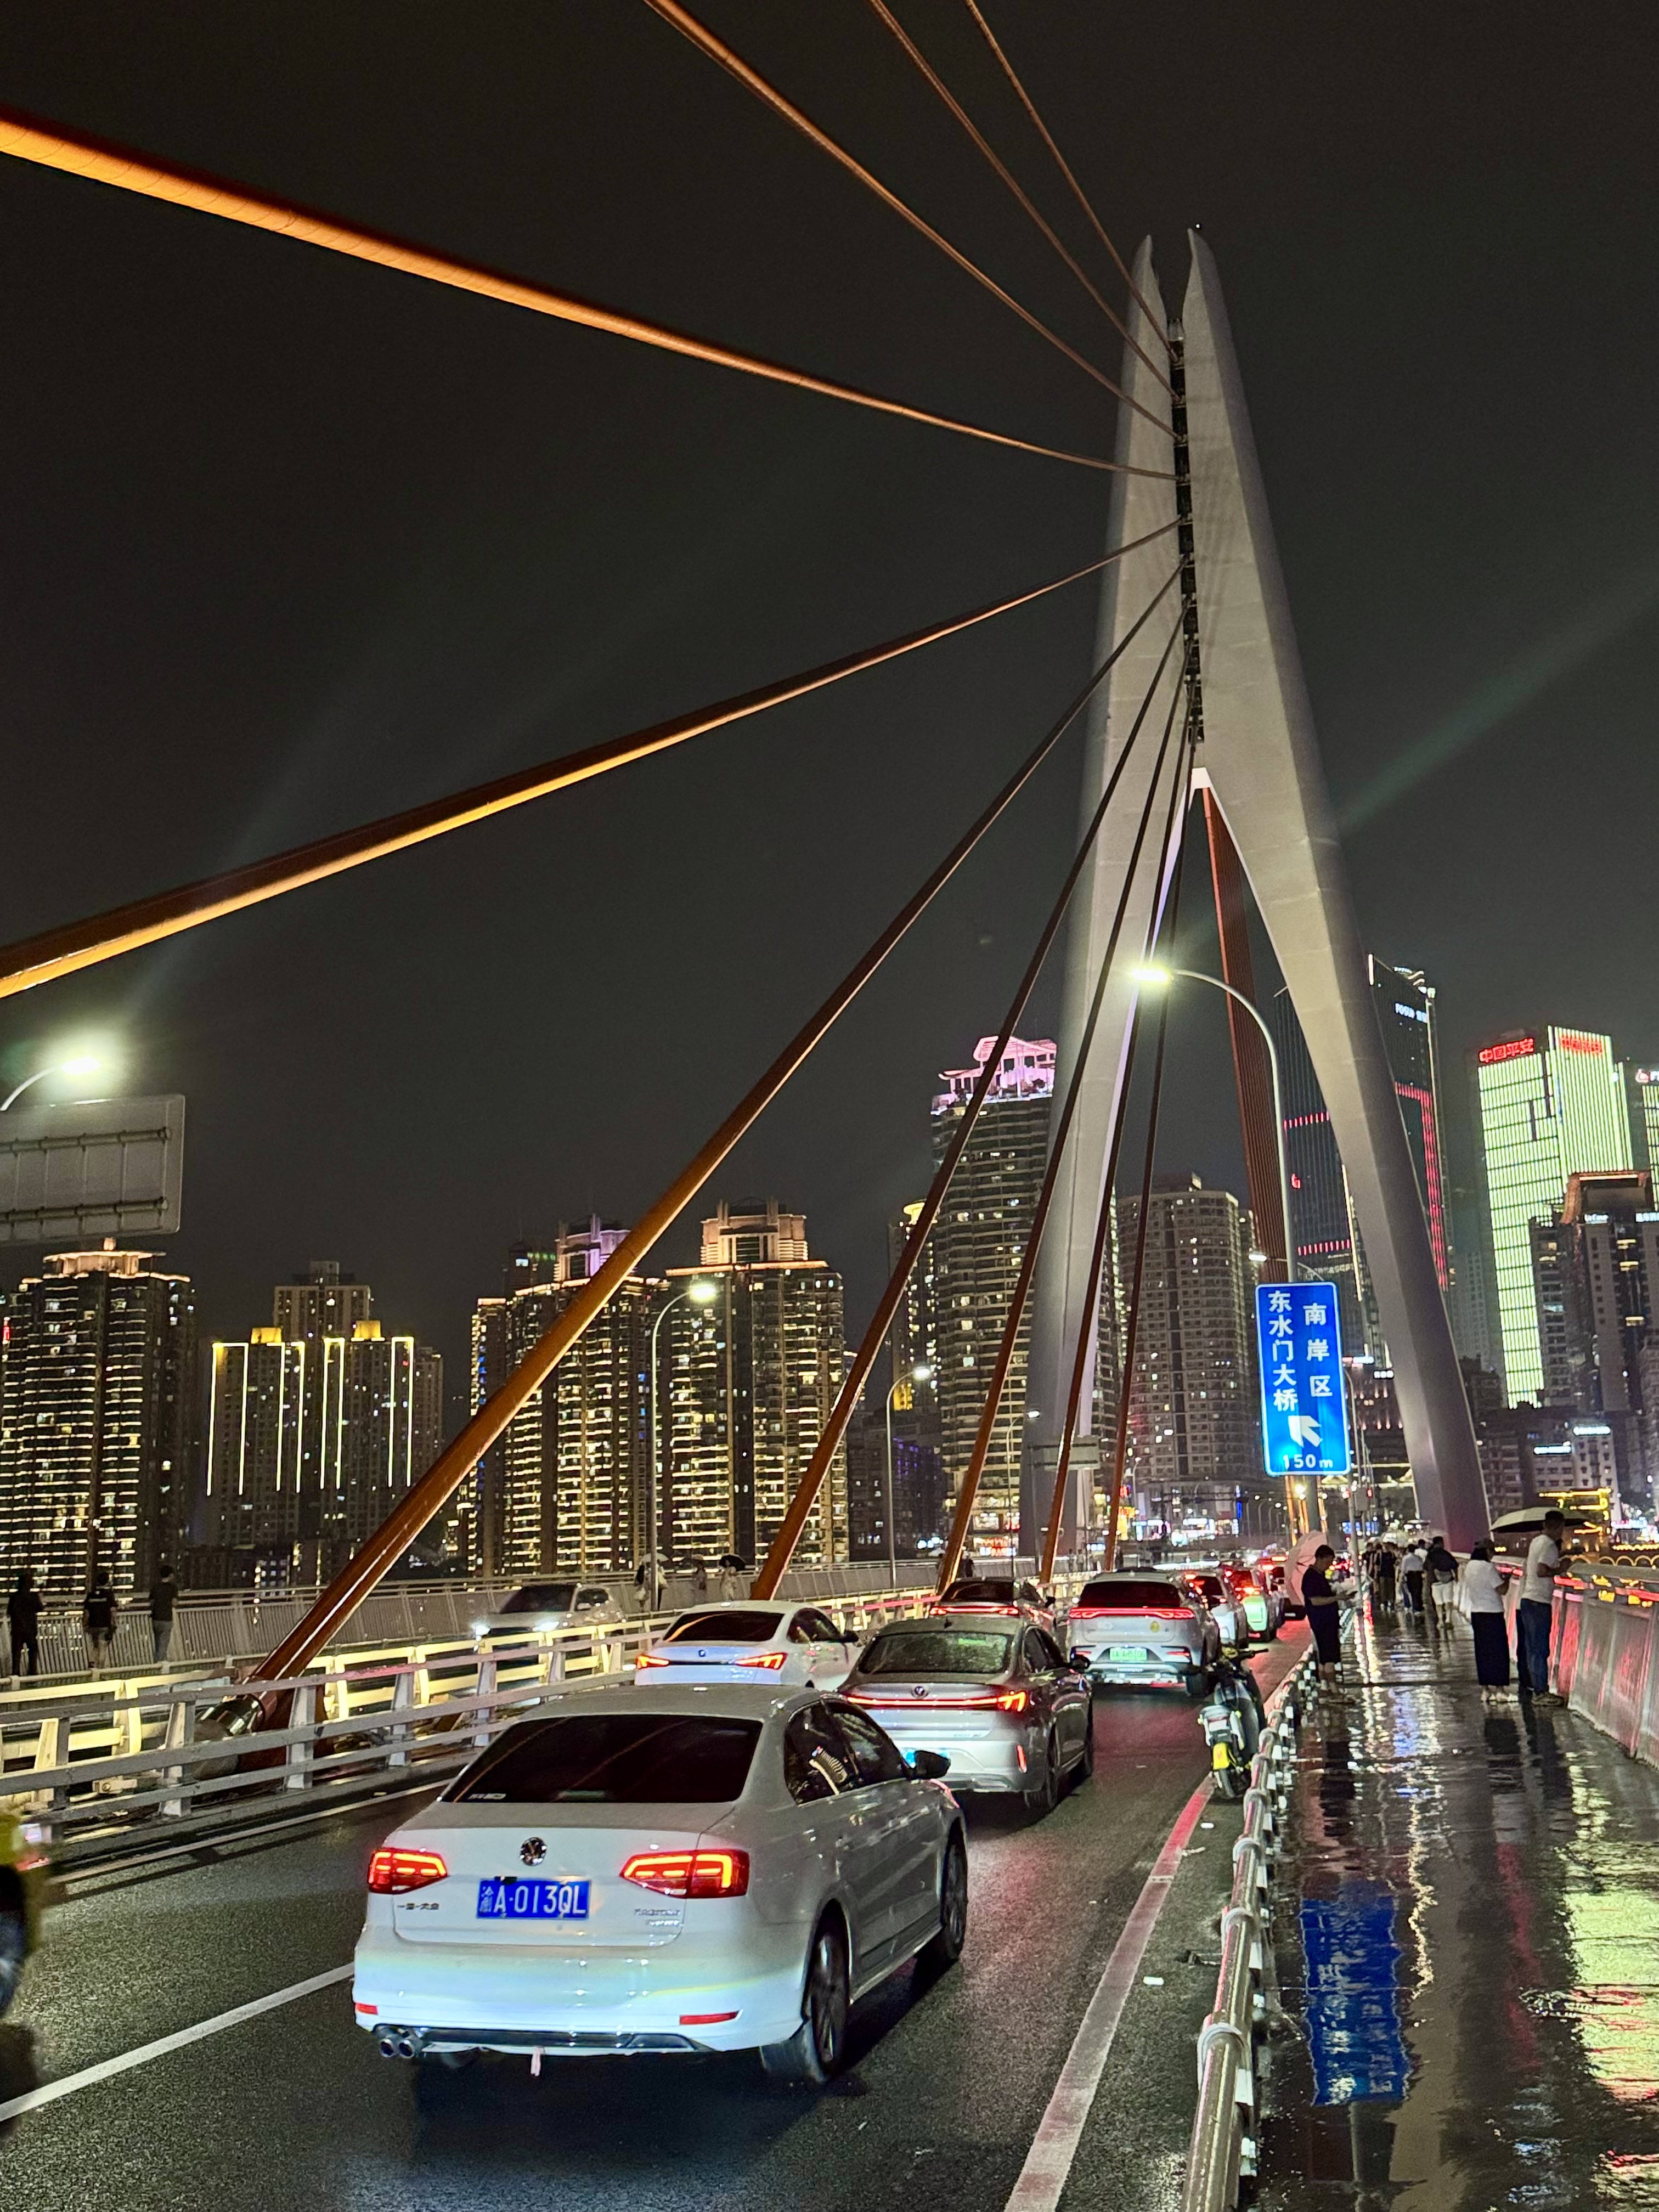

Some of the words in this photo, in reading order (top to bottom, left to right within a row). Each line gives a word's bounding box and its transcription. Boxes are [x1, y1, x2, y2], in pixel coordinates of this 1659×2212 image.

[1480, 1038, 1534, 1063] 中国平安
[1268, 1290, 1299, 1412] 东水门大桥
[1303, 1302, 1333, 1397] 南岸区
